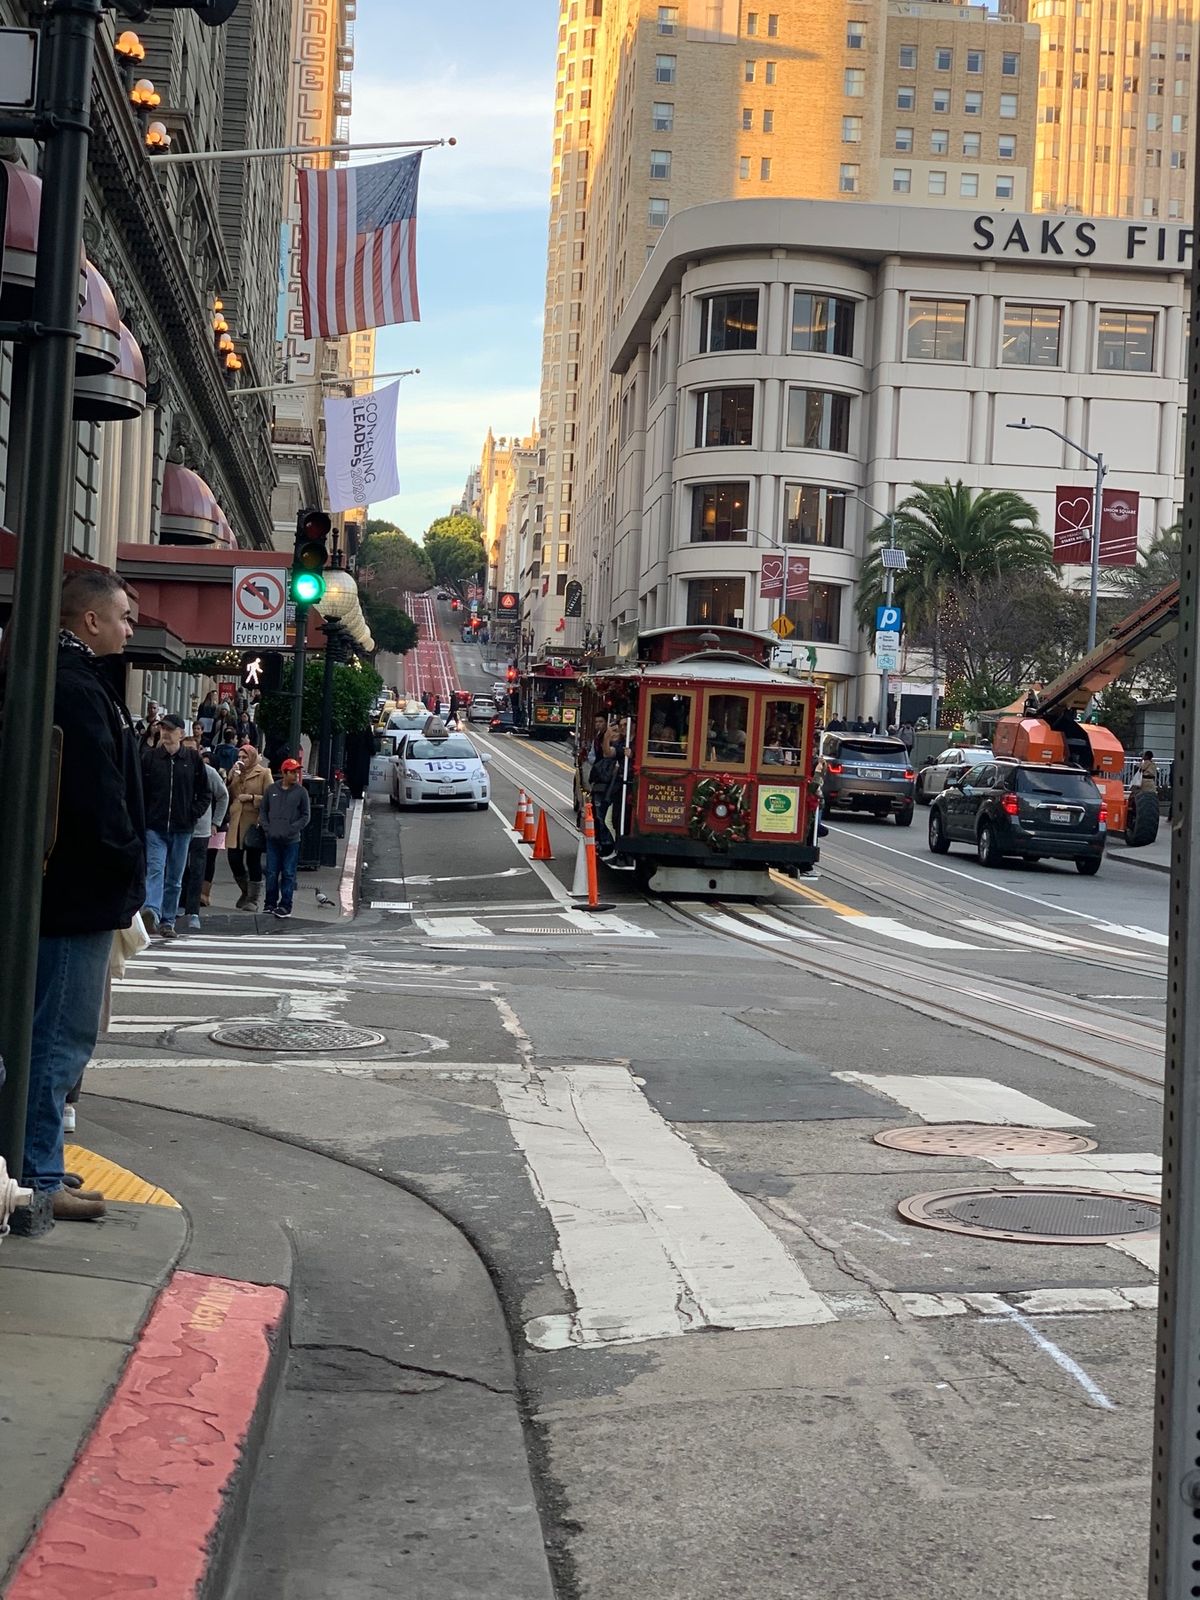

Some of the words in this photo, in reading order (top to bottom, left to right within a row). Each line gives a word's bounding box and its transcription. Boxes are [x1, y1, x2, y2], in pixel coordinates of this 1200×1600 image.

[294, 0, 327, 204] NCELLO
[973, 215, 1096, 257] SAKS
[350, 467, 366, 503] 2020
[236, 621, 282, 632] 7AM-10PM
[236, 634, 281, 644] EVERYDAY
[424, 760, 467, 772] 1135
[648, 784, 685, 793] POWELL
[647, 794, 685, 802] MARKET
